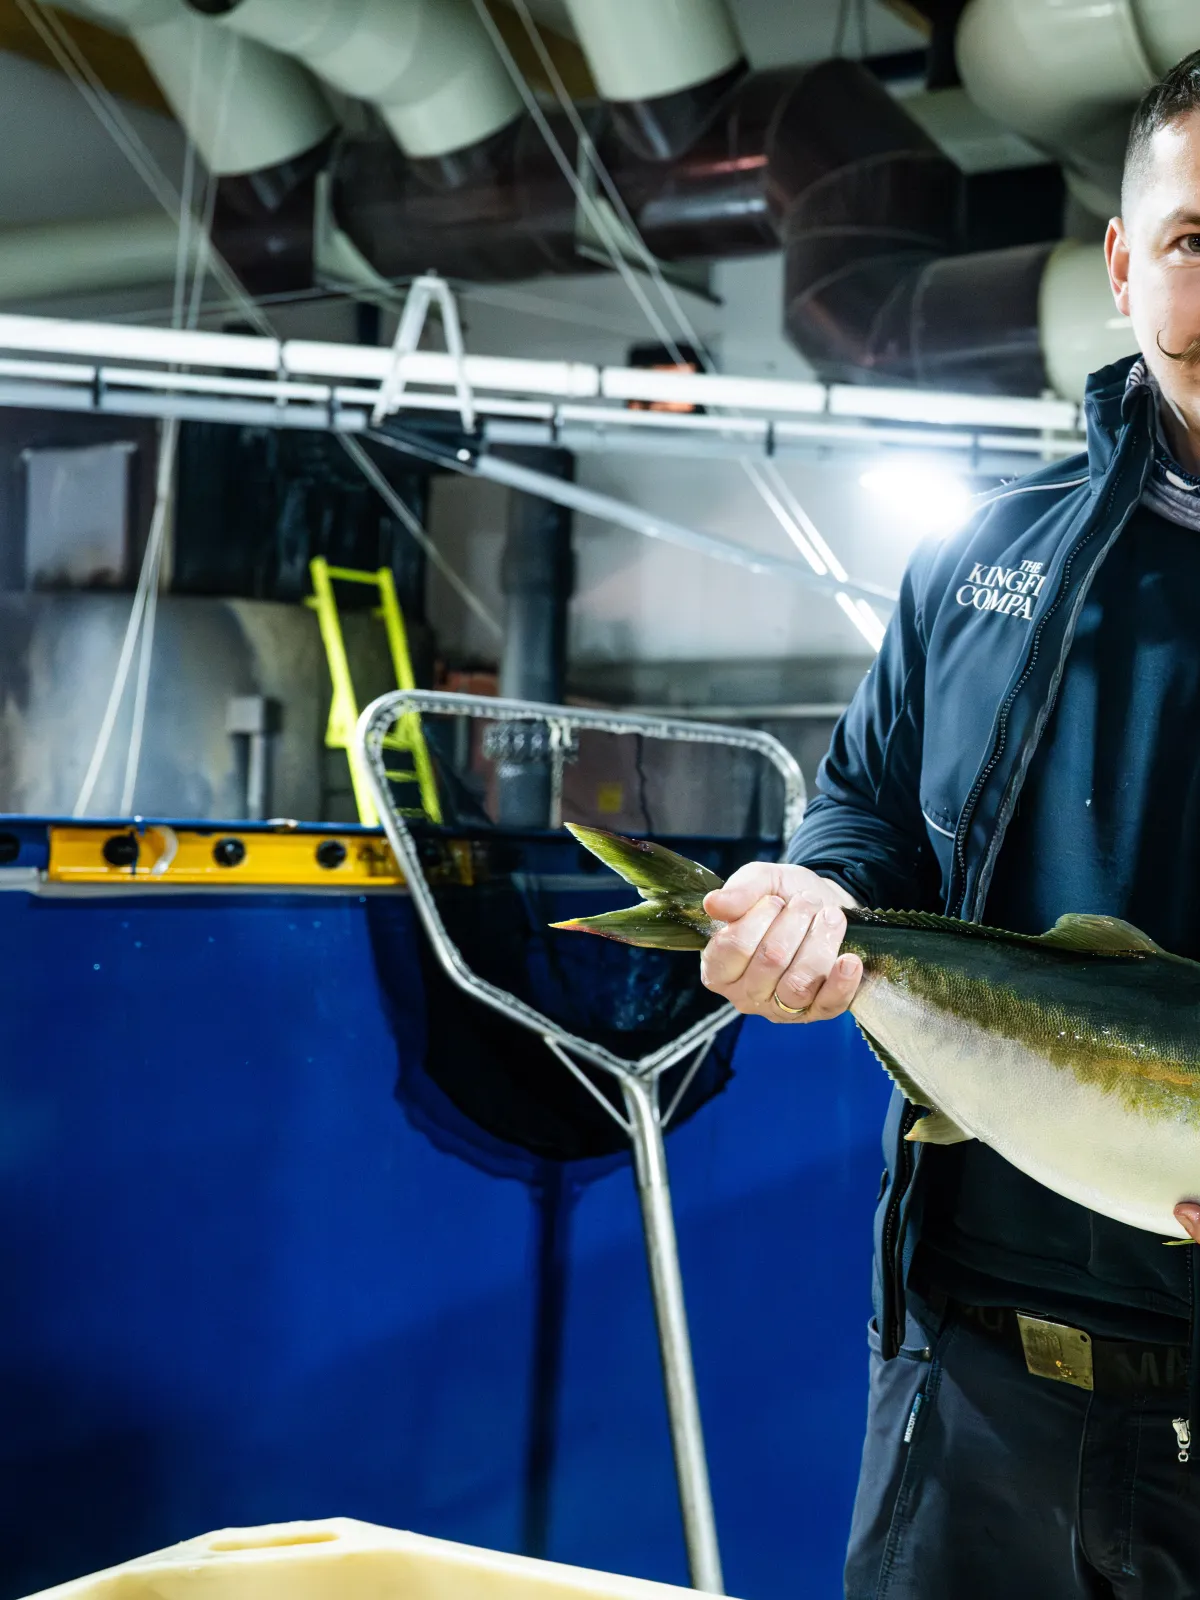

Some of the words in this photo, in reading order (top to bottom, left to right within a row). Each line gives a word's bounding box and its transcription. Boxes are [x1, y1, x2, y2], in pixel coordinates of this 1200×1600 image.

[966, 562, 1046, 597] KINGFI
[1019, 559, 1043, 574] THE
[956, 584, 1033, 621] COMPA
